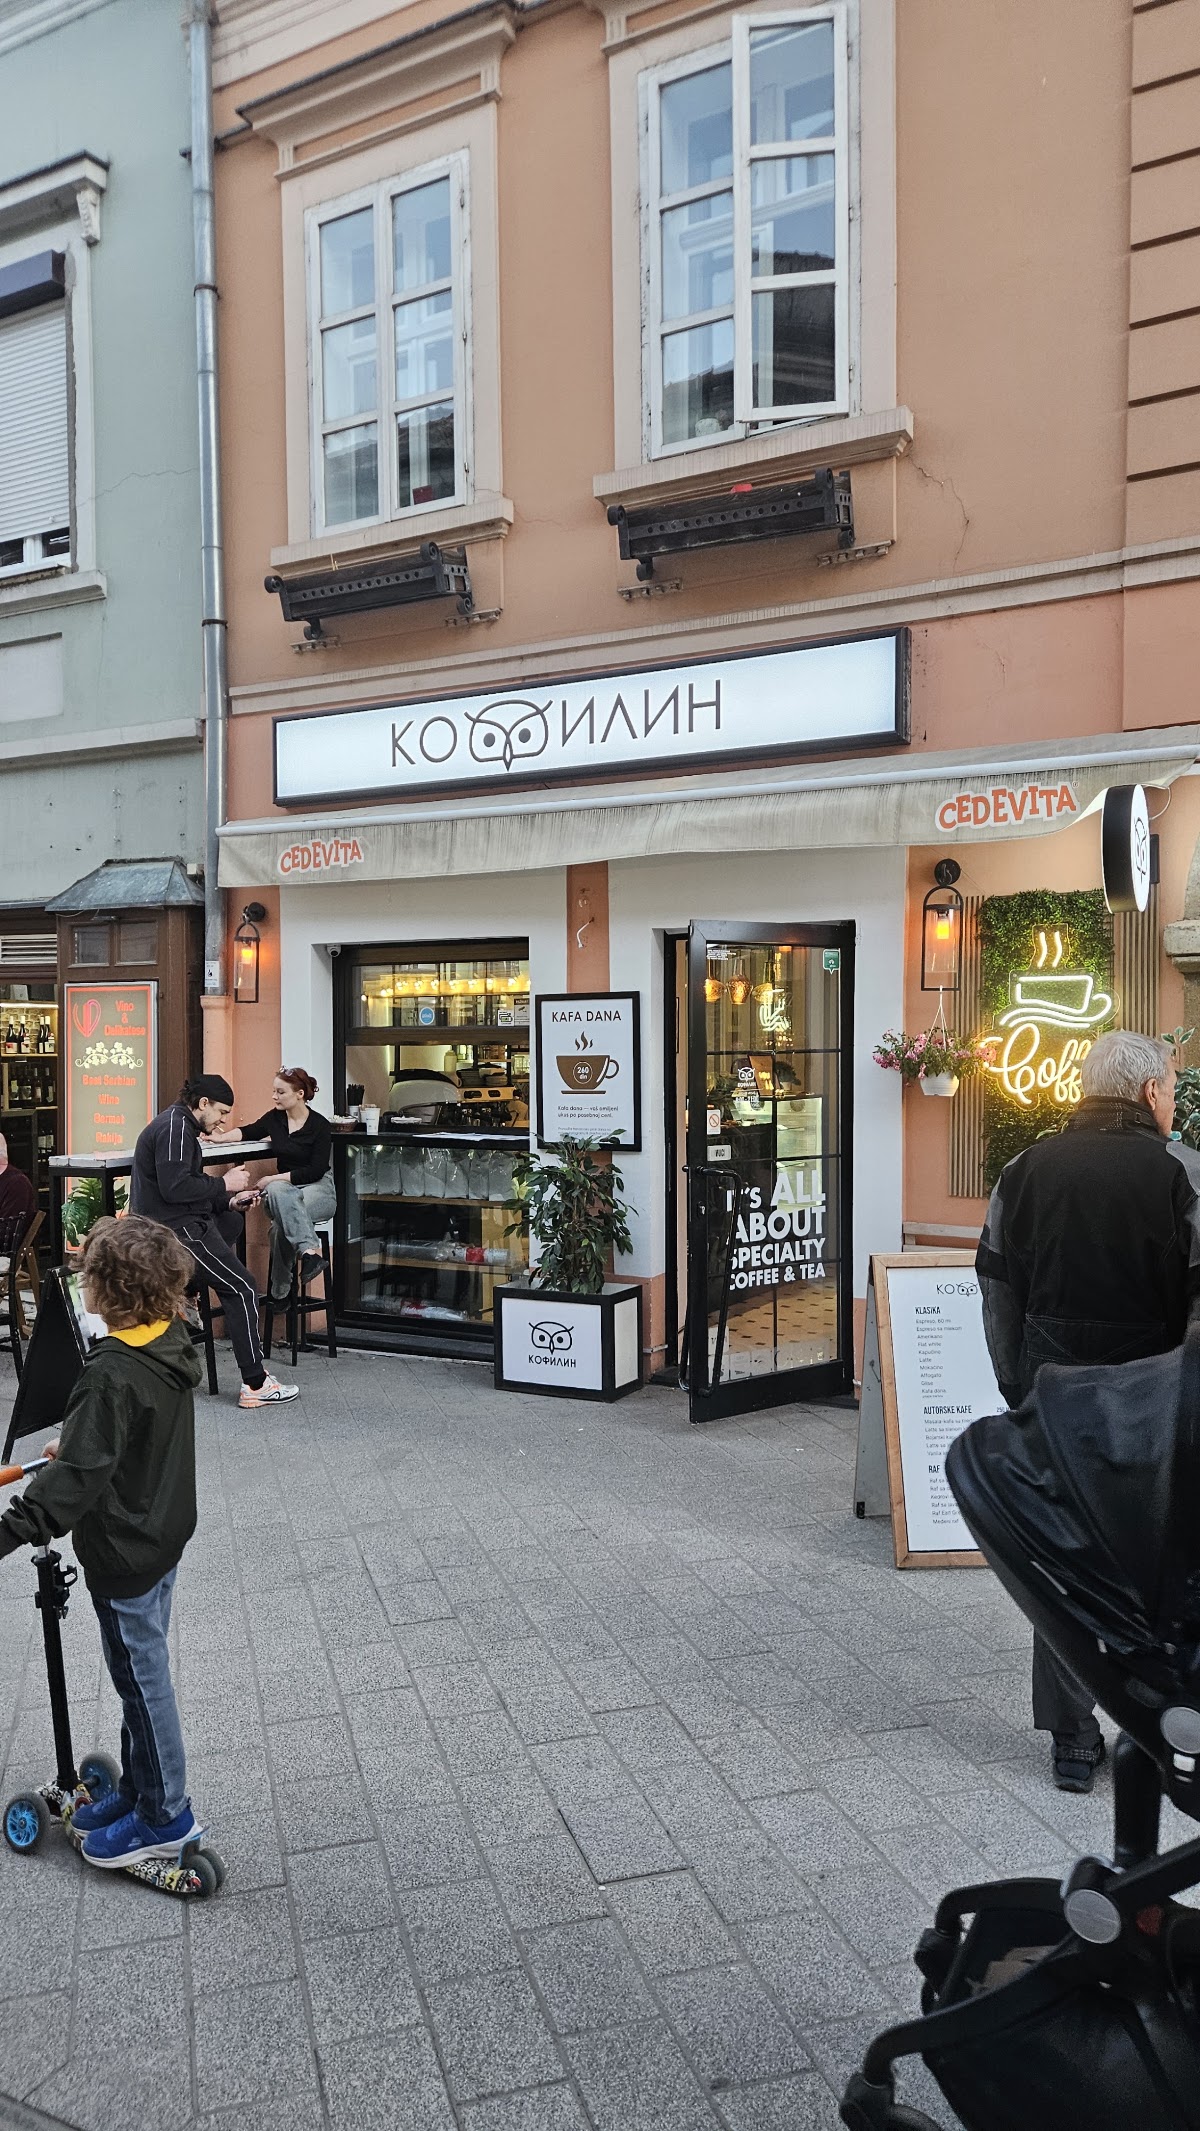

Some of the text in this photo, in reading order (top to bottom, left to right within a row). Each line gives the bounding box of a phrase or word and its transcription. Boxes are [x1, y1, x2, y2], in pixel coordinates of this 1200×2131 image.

[939, 785, 1077, 829] CEDEVITA
[280, 839, 362, 873] CEDEVITA
[552, 1010, 622, 1022] KAFA DANA
[577, 1066, 590, 1074] 260
[980, 1023, 1092, 1104] Coff
[770, 1169, 826, 1207] ALL
[735, 1205, 826, 1243] ABOUT
[784, 1265, 796, 1282] &
[799, 1262, 826, 1280] TEA
[915, 1306, 941, 1315] KLASIKA
[528, 1354, 577, 1368] КОФИЛИН
[923, 1405, 972, 1415] AUTORSKE KAFE
[928, 1464, 940, 1473] RAF
